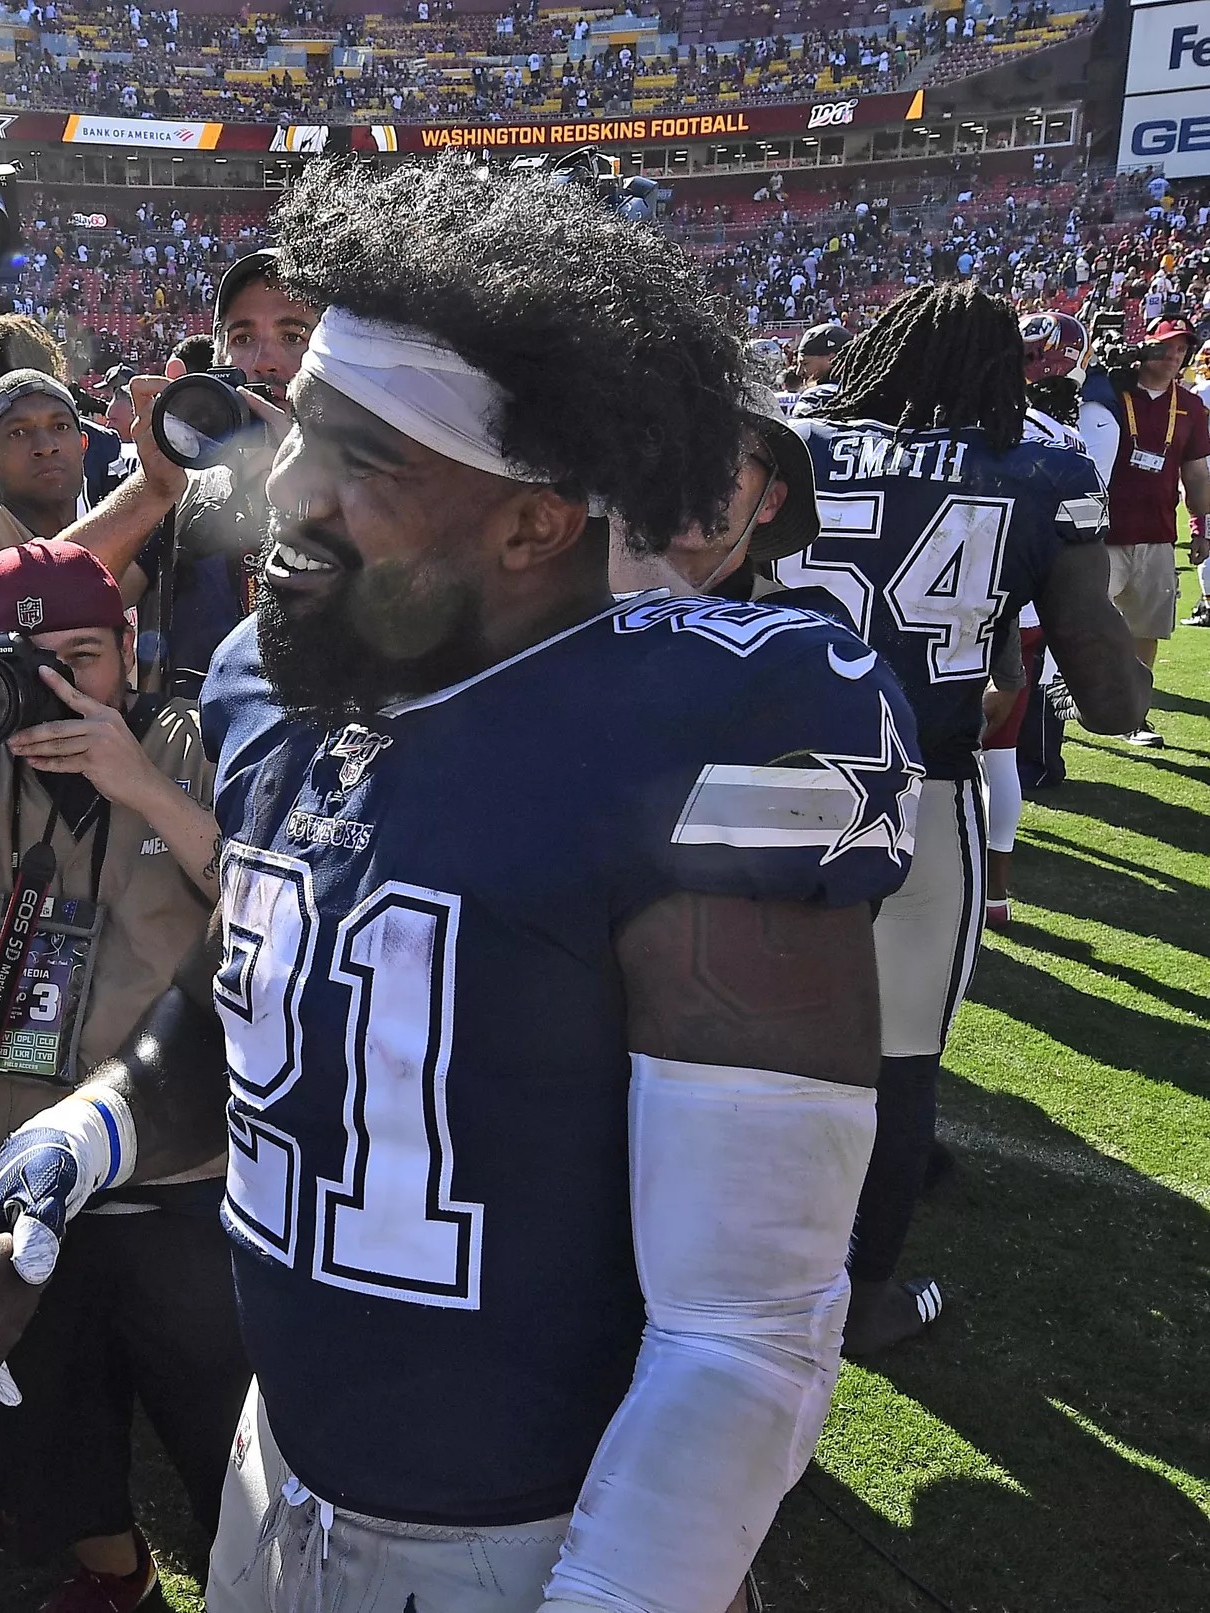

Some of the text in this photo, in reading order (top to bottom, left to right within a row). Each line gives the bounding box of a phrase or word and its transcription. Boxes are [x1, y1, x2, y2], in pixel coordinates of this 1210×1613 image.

[1169, 25, 1210, 70] Fe
[82, 127, 172, 141] BANK OF AMERICA
[422, 113, 749, 147] WASHINGTON REDSKINS FOOTBALL
[1131, 116, 1210, 156] GE
[829, 437, 969, 483] SMITH
[771, 490, 1016, 685] 54
[286, 809, 375, 851] COWBOYS
[13, 888, 38, 935] EOS
[5, 936, 24, 961] 5D
[29, 982, 60, 1021] 3
[4, 1061, 18, 1069] FIELD
[14, 1050, 30, 1059] LKR
[214, 841, 484, 1310] 21
